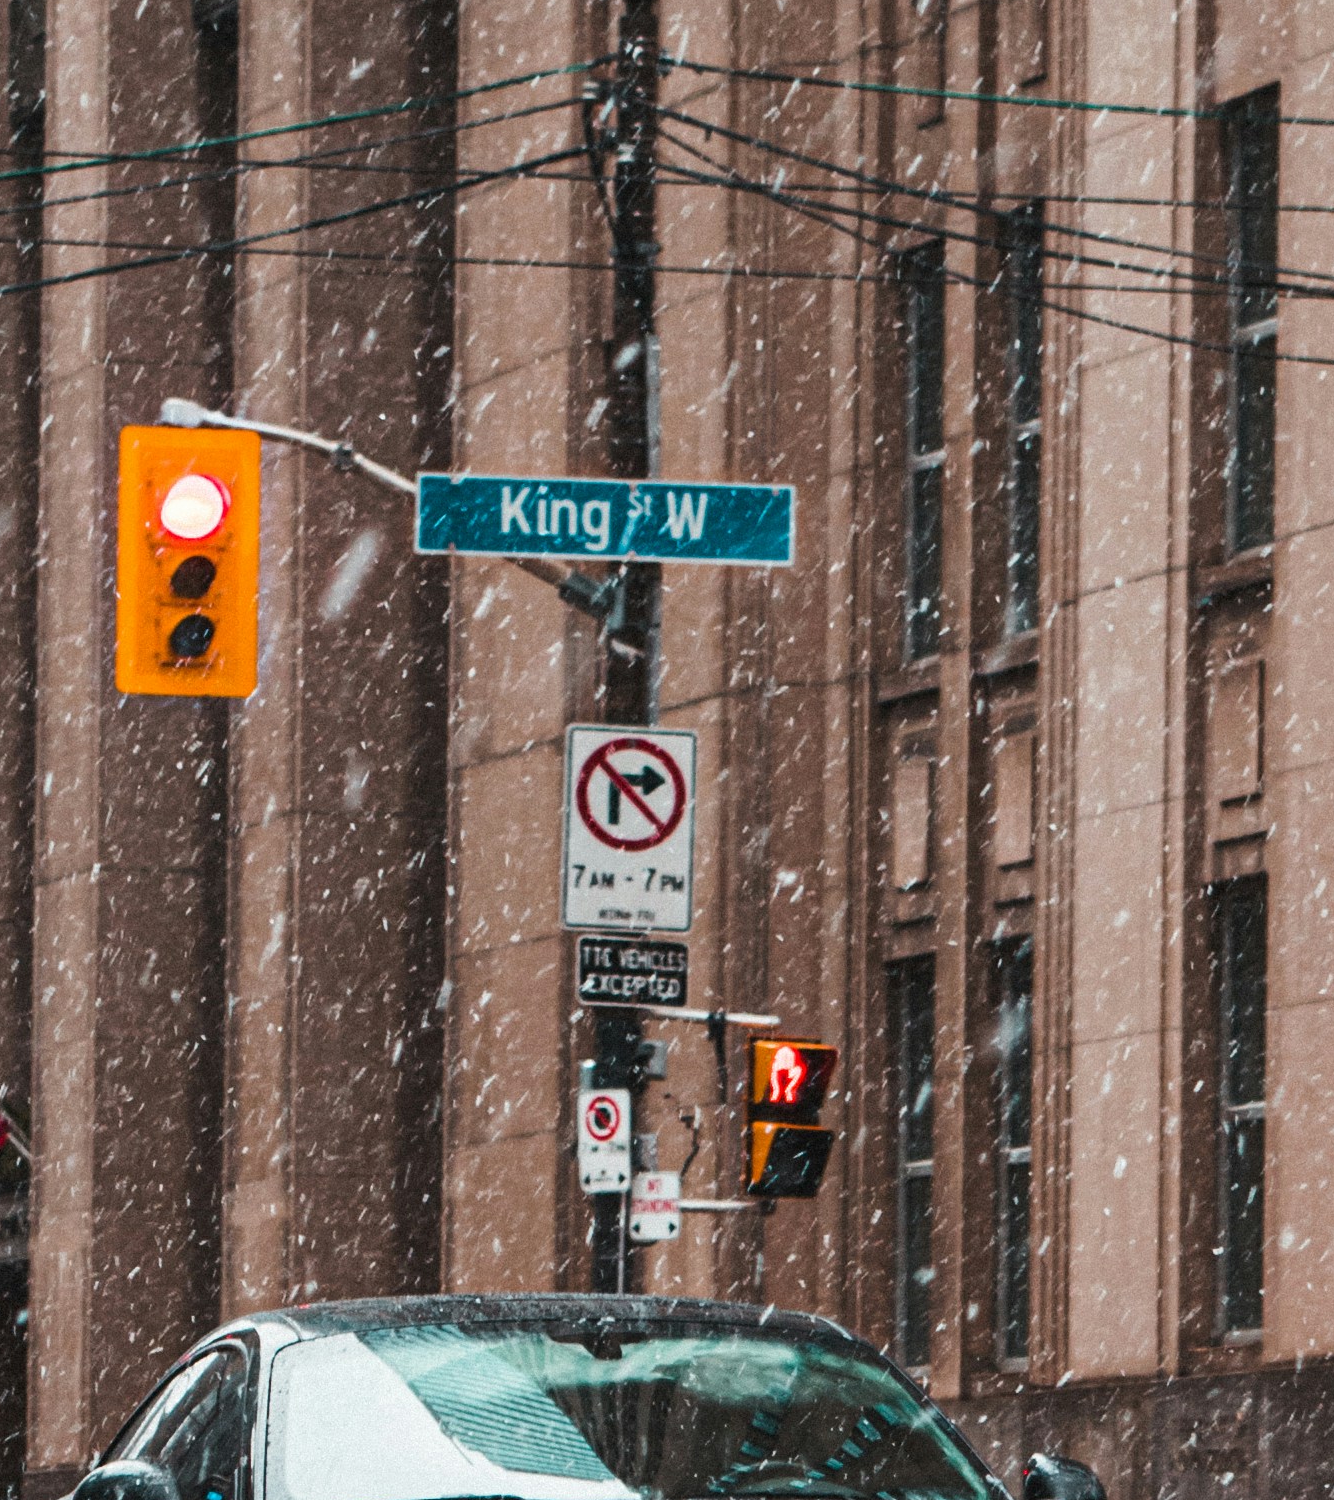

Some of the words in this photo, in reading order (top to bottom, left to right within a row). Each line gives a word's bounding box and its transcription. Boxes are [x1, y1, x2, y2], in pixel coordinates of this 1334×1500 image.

[500, 485, 611, 551] King
[628, 490, 652, 519] St
[667, 490, 709, 540] W
